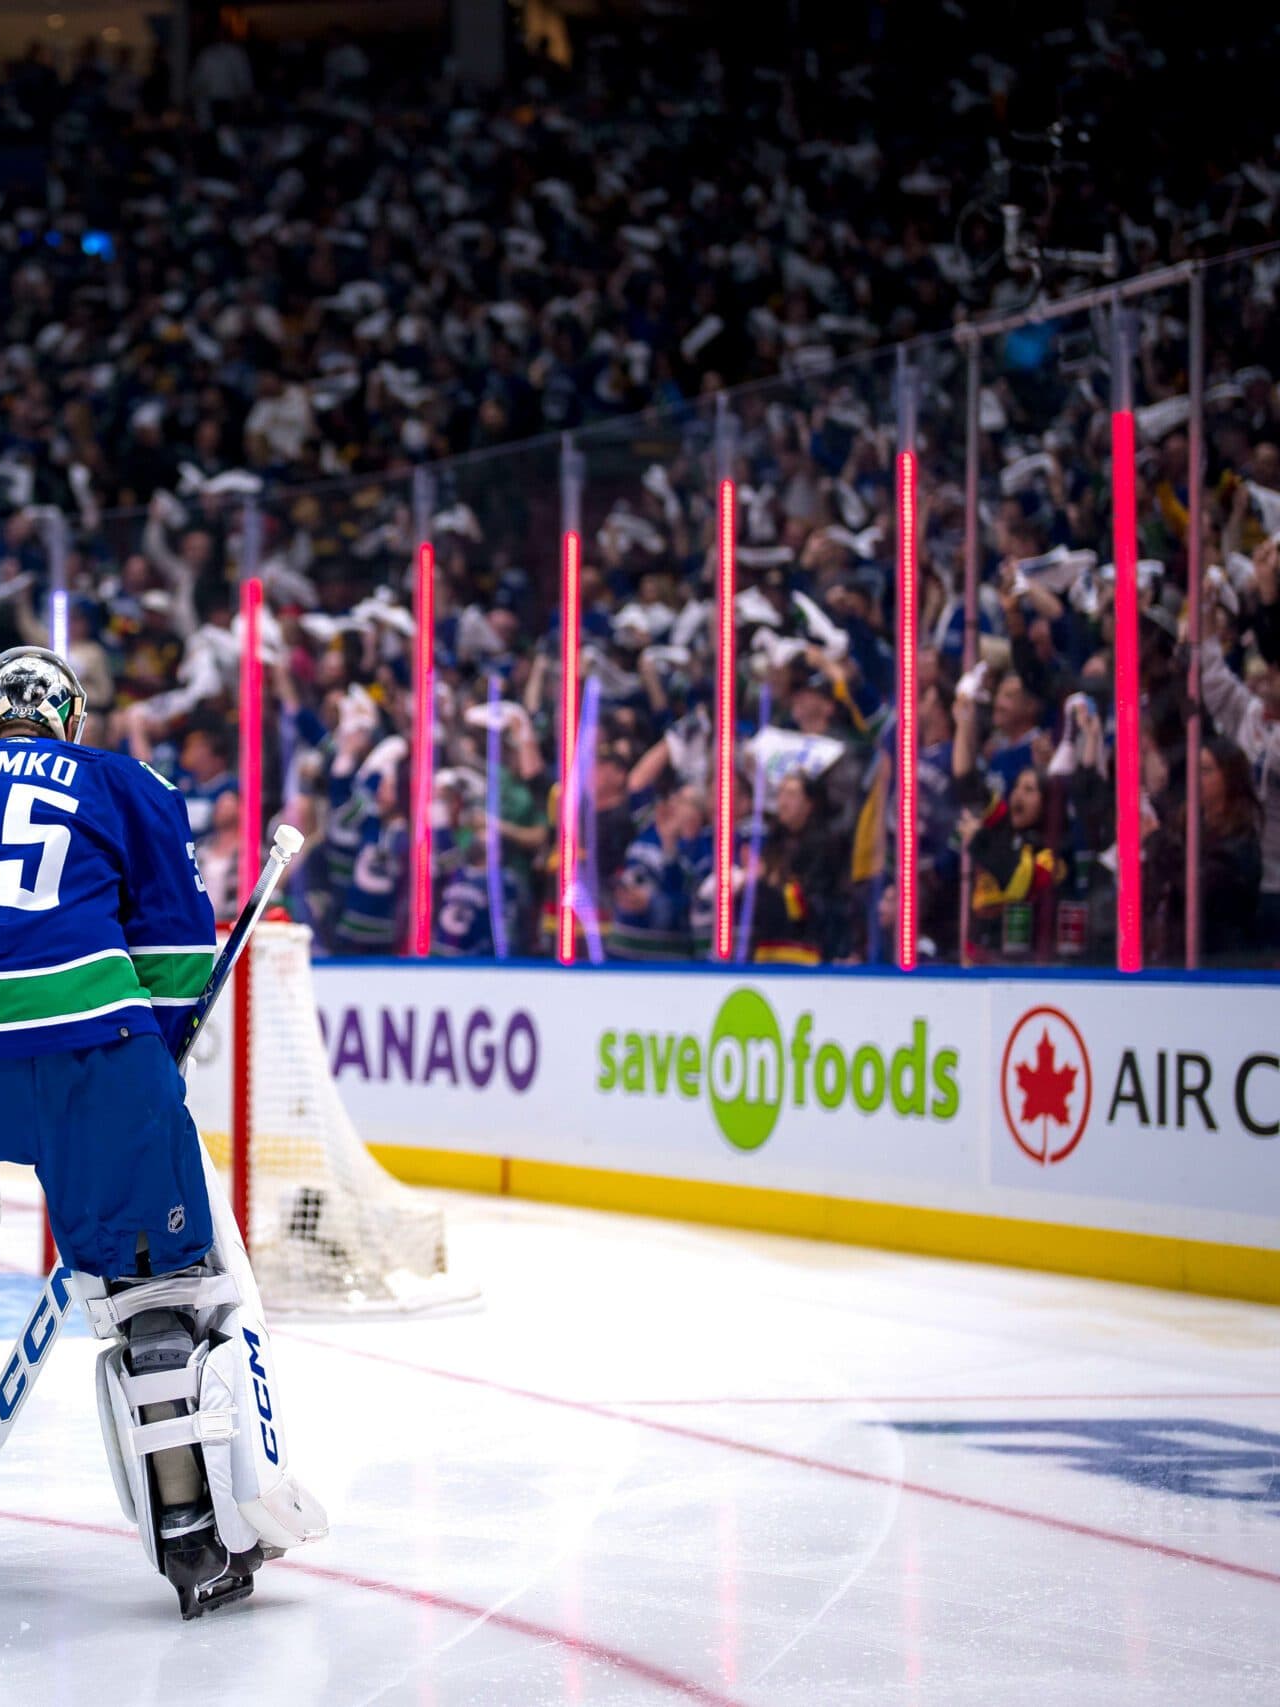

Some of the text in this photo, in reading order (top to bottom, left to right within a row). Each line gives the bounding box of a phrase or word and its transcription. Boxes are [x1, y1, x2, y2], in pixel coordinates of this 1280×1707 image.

[317, 1006, 539, 1093] ANAGO
[598, 1012, 960, 1121] save on foods
[1106, 1049, 1219, 1134] AIR
[241, 1326, 280, 1467] CCM
